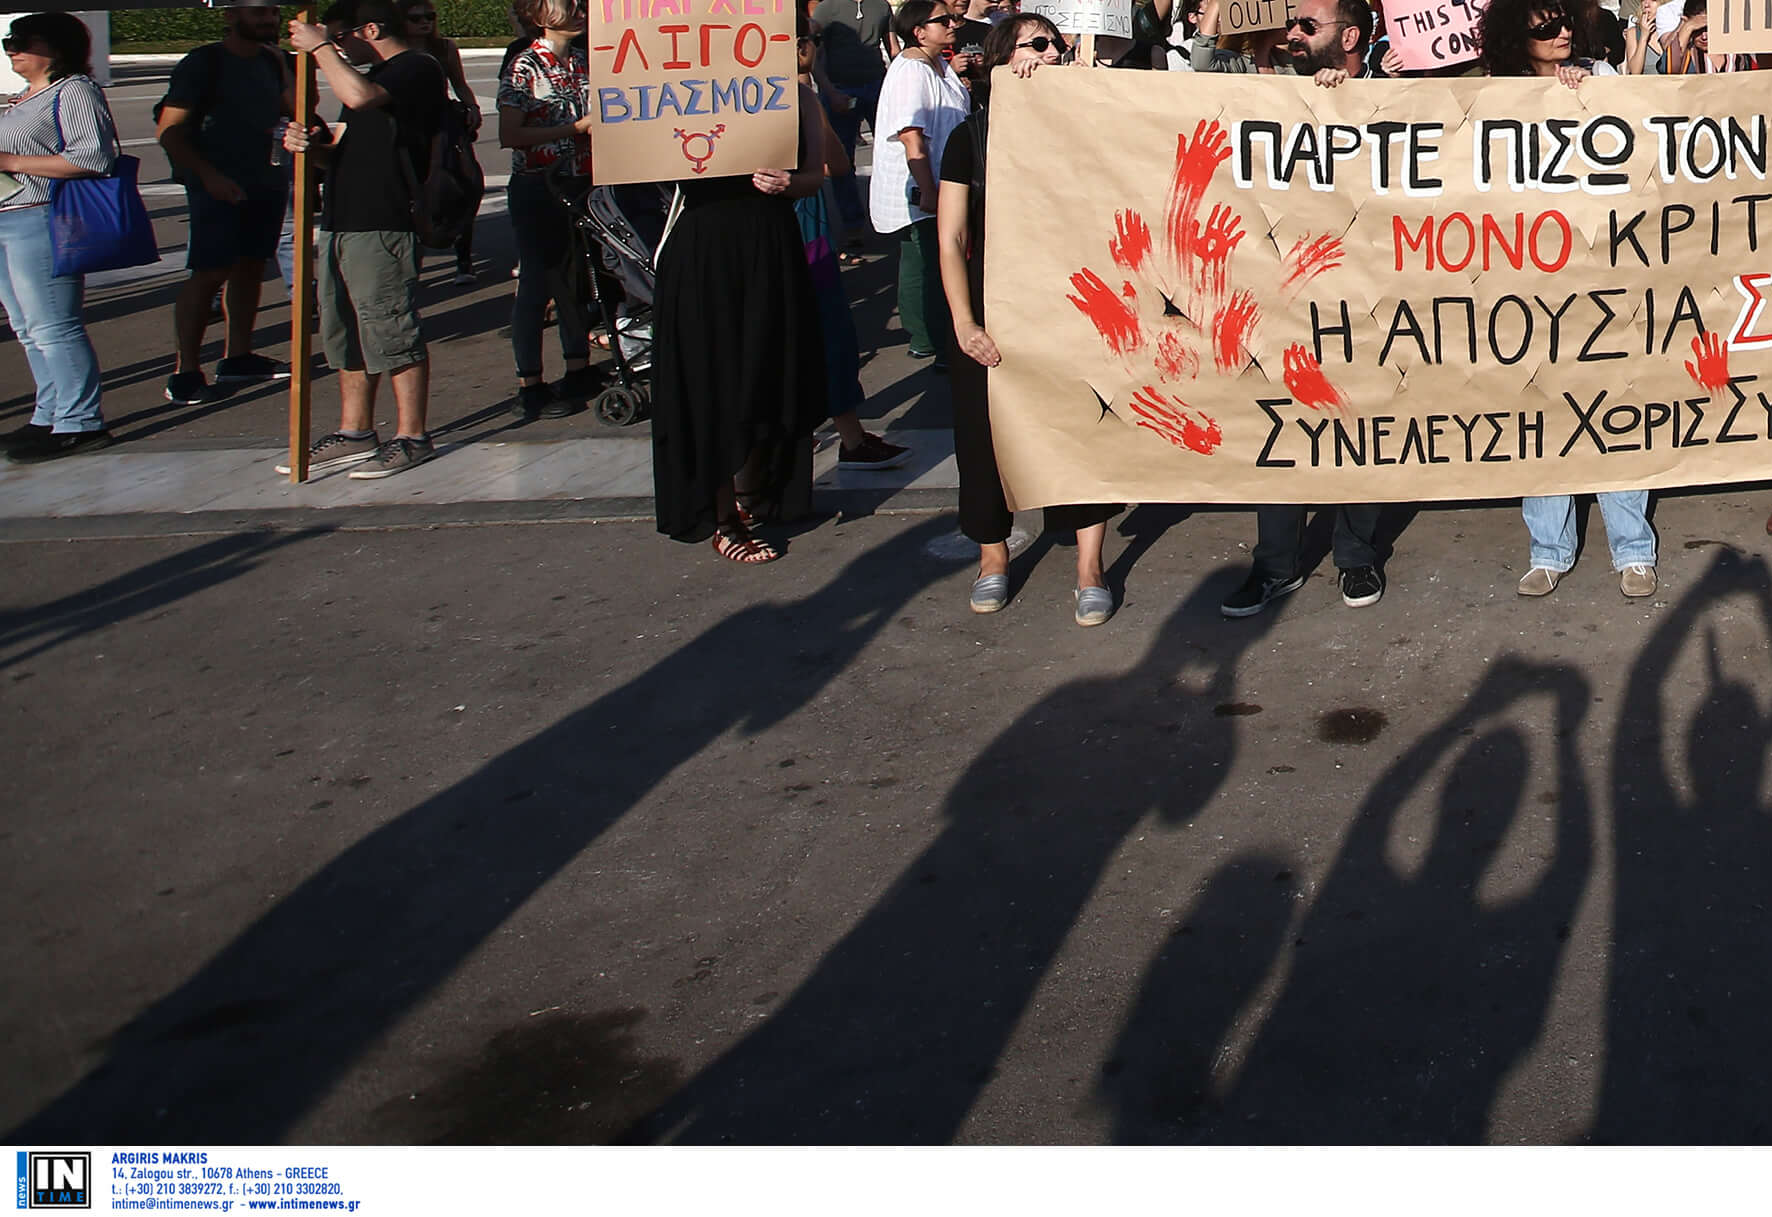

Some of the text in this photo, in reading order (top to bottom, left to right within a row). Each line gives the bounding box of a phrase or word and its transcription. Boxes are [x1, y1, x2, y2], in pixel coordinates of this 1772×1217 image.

[1394, 4, 1450, 37] THIS
[598, 76, 791, 124] ΒΙΑΣΜΟΣ
[1232, 120, 1444, 196] ΠΑΡΤΕ
[1474, 115, 1635, 195] ΠΙΣΩ
[1643, 114, 1768, 184] ΤΟΝ
[1393, 210, 1573, 272] ΜΟΝΟ
[1309, 299, 1353, 365] Η
[1378, 285, 1706, 366] ΑΠΟΥΣΙΑ
[1255, 398, 1548, 469] ΣΥΝΕΛΕΥΣΗ
[1559, 390, 1711, 459] ΧΩΡΙΣ
